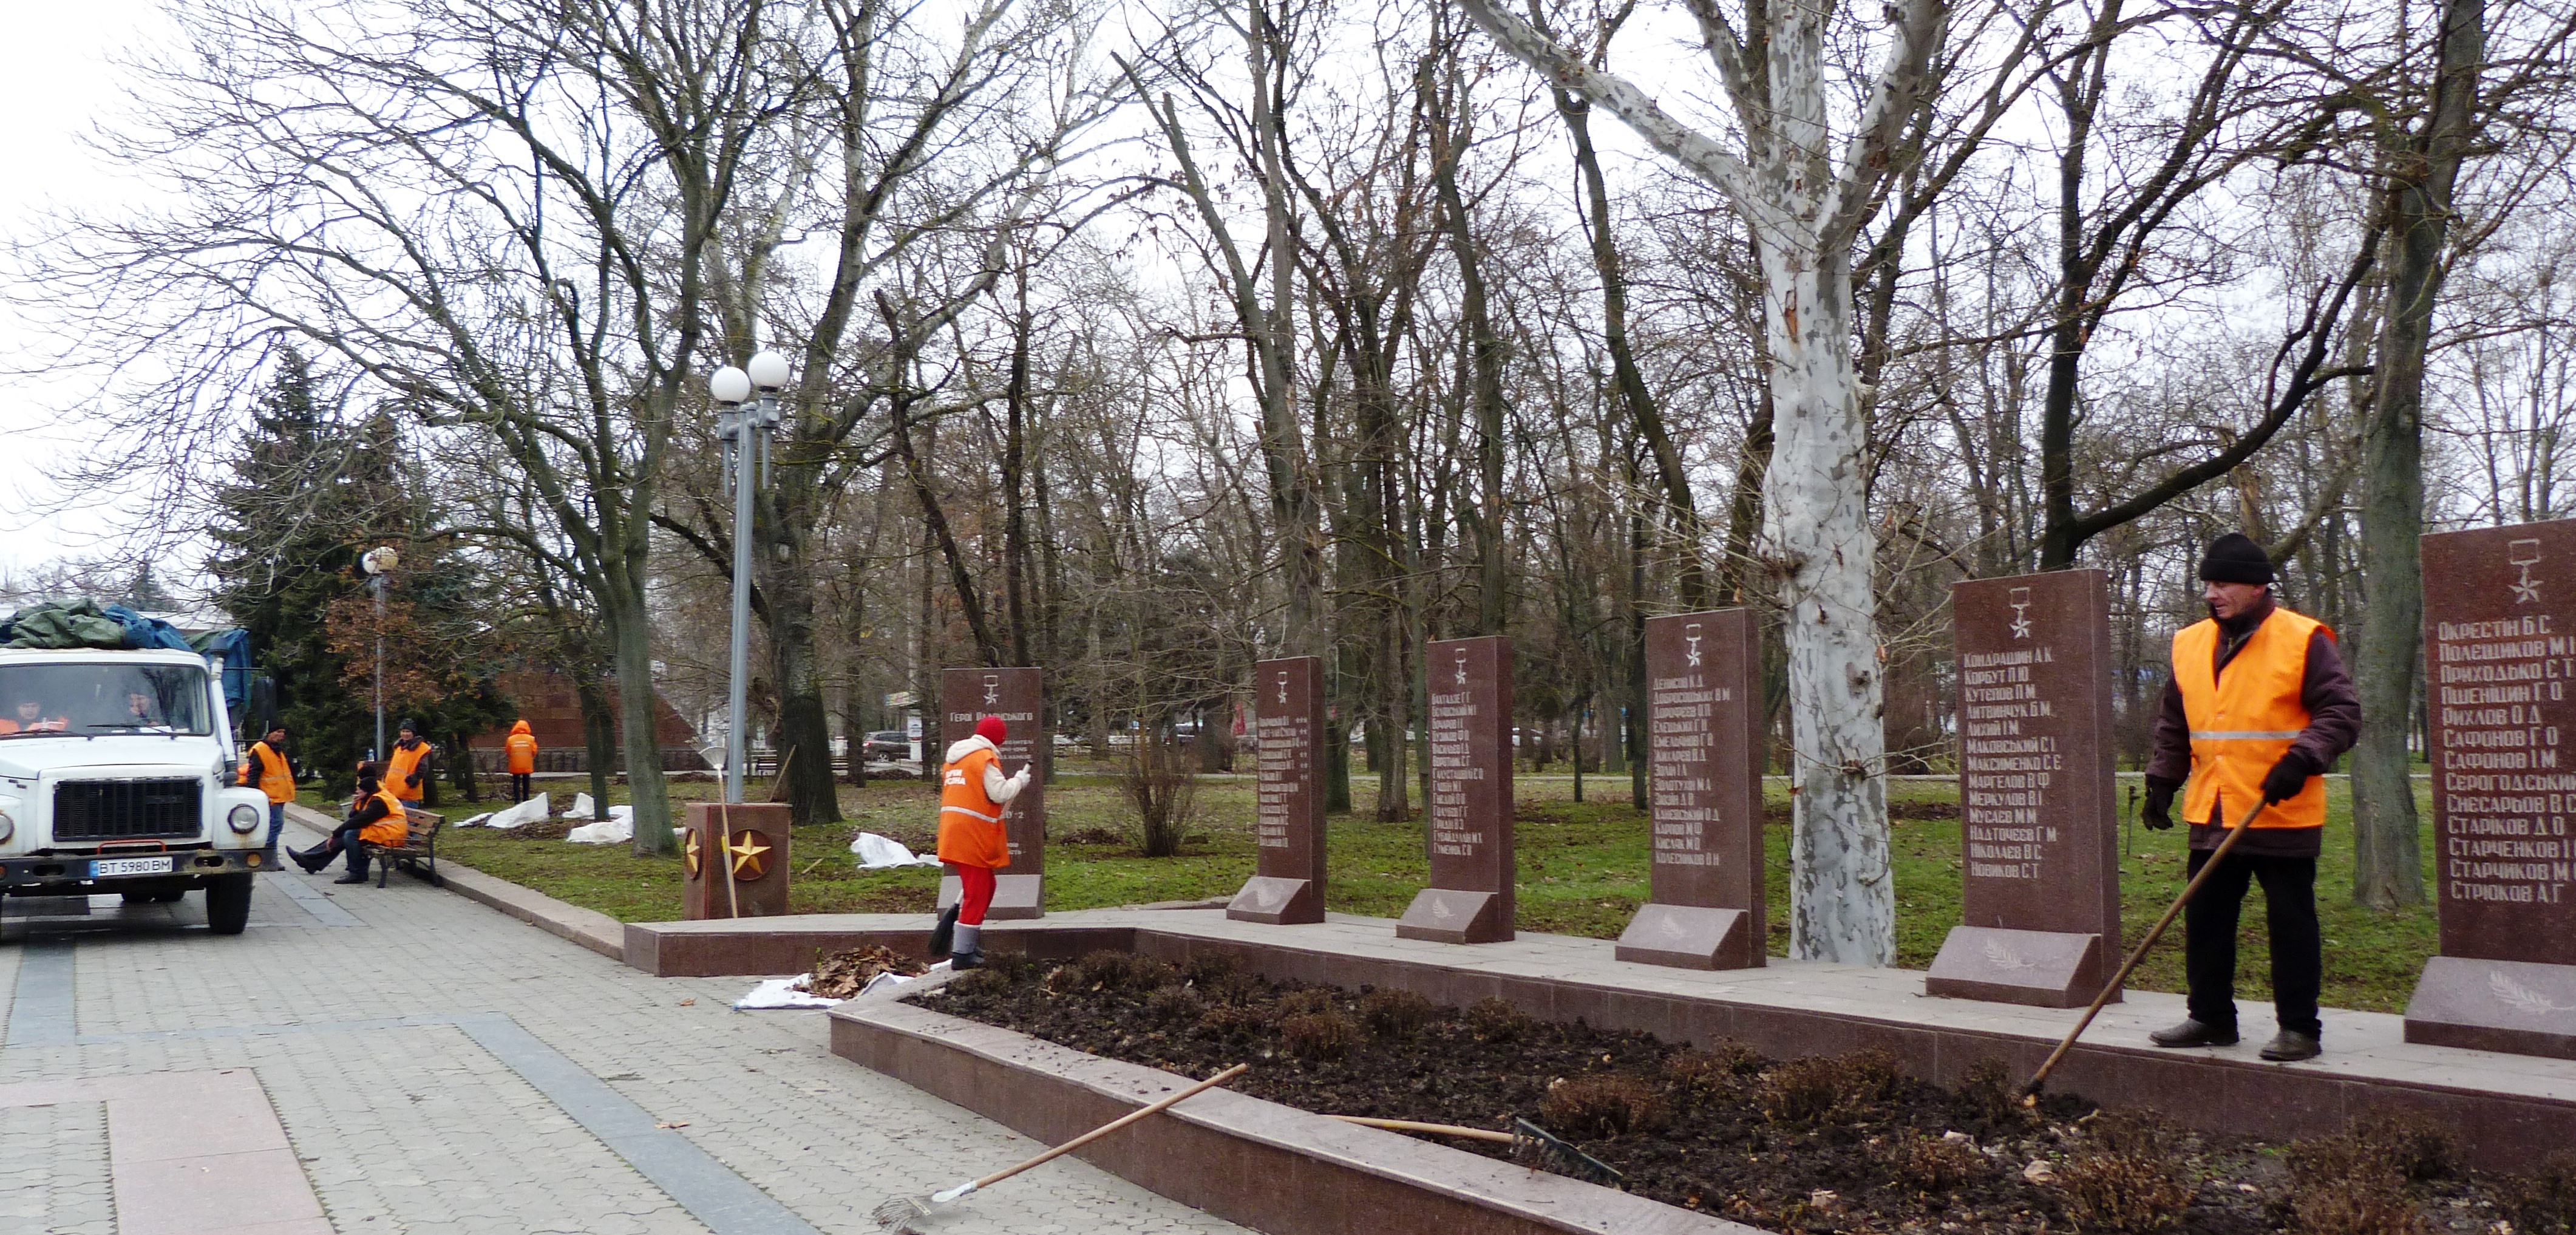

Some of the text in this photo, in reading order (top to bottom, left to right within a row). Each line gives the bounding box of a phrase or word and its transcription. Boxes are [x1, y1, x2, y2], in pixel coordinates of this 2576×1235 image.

[2523, 616, 2534, 635] Б
[2538, 615, 2551, 634] С
[2551, 636, 2564, 656] М
[1965, 670, 2005, 685] КОРБУТ
[2440, 658, 2574, 683] ПРИХОДЬКО С Т
[2534, 682, 2545, 701] Г
[2442, 707, 2507, 726] РИХЛОВ
[2527, 705, 2541, 724] Д
[1967, 737, 2039, 754] МАКОВСЬКИЙ
[2443, 729, 2526, 747] САФОНОВ
[2530, 727, 2541, 746] Г
[1967, 755, 2041, 771] МАКСИМЕНКО
[2444, 750, 2527, 769] САФОНОВ
[2541, 749, 2556, 768] М
[1968, 773, 2025, 788] МАРГЕЛОВ
[1969, 791, 2026, 806] МЕРКУЛОВ
[2550, 794, 2561, 813] В
[2447, 815, 2529, 835] СТАРІКОВ
[2534, 817, 2548, 835] Д
[2449, 837, 2559, 858] СТАРЧЕНКОВ
[121, 861, 150, 872] 5980
[2450, 858, 2549, 880] СТАРЧИКОВ
[2451, 880, 2564, 903] СТРЮКОВ А Г
